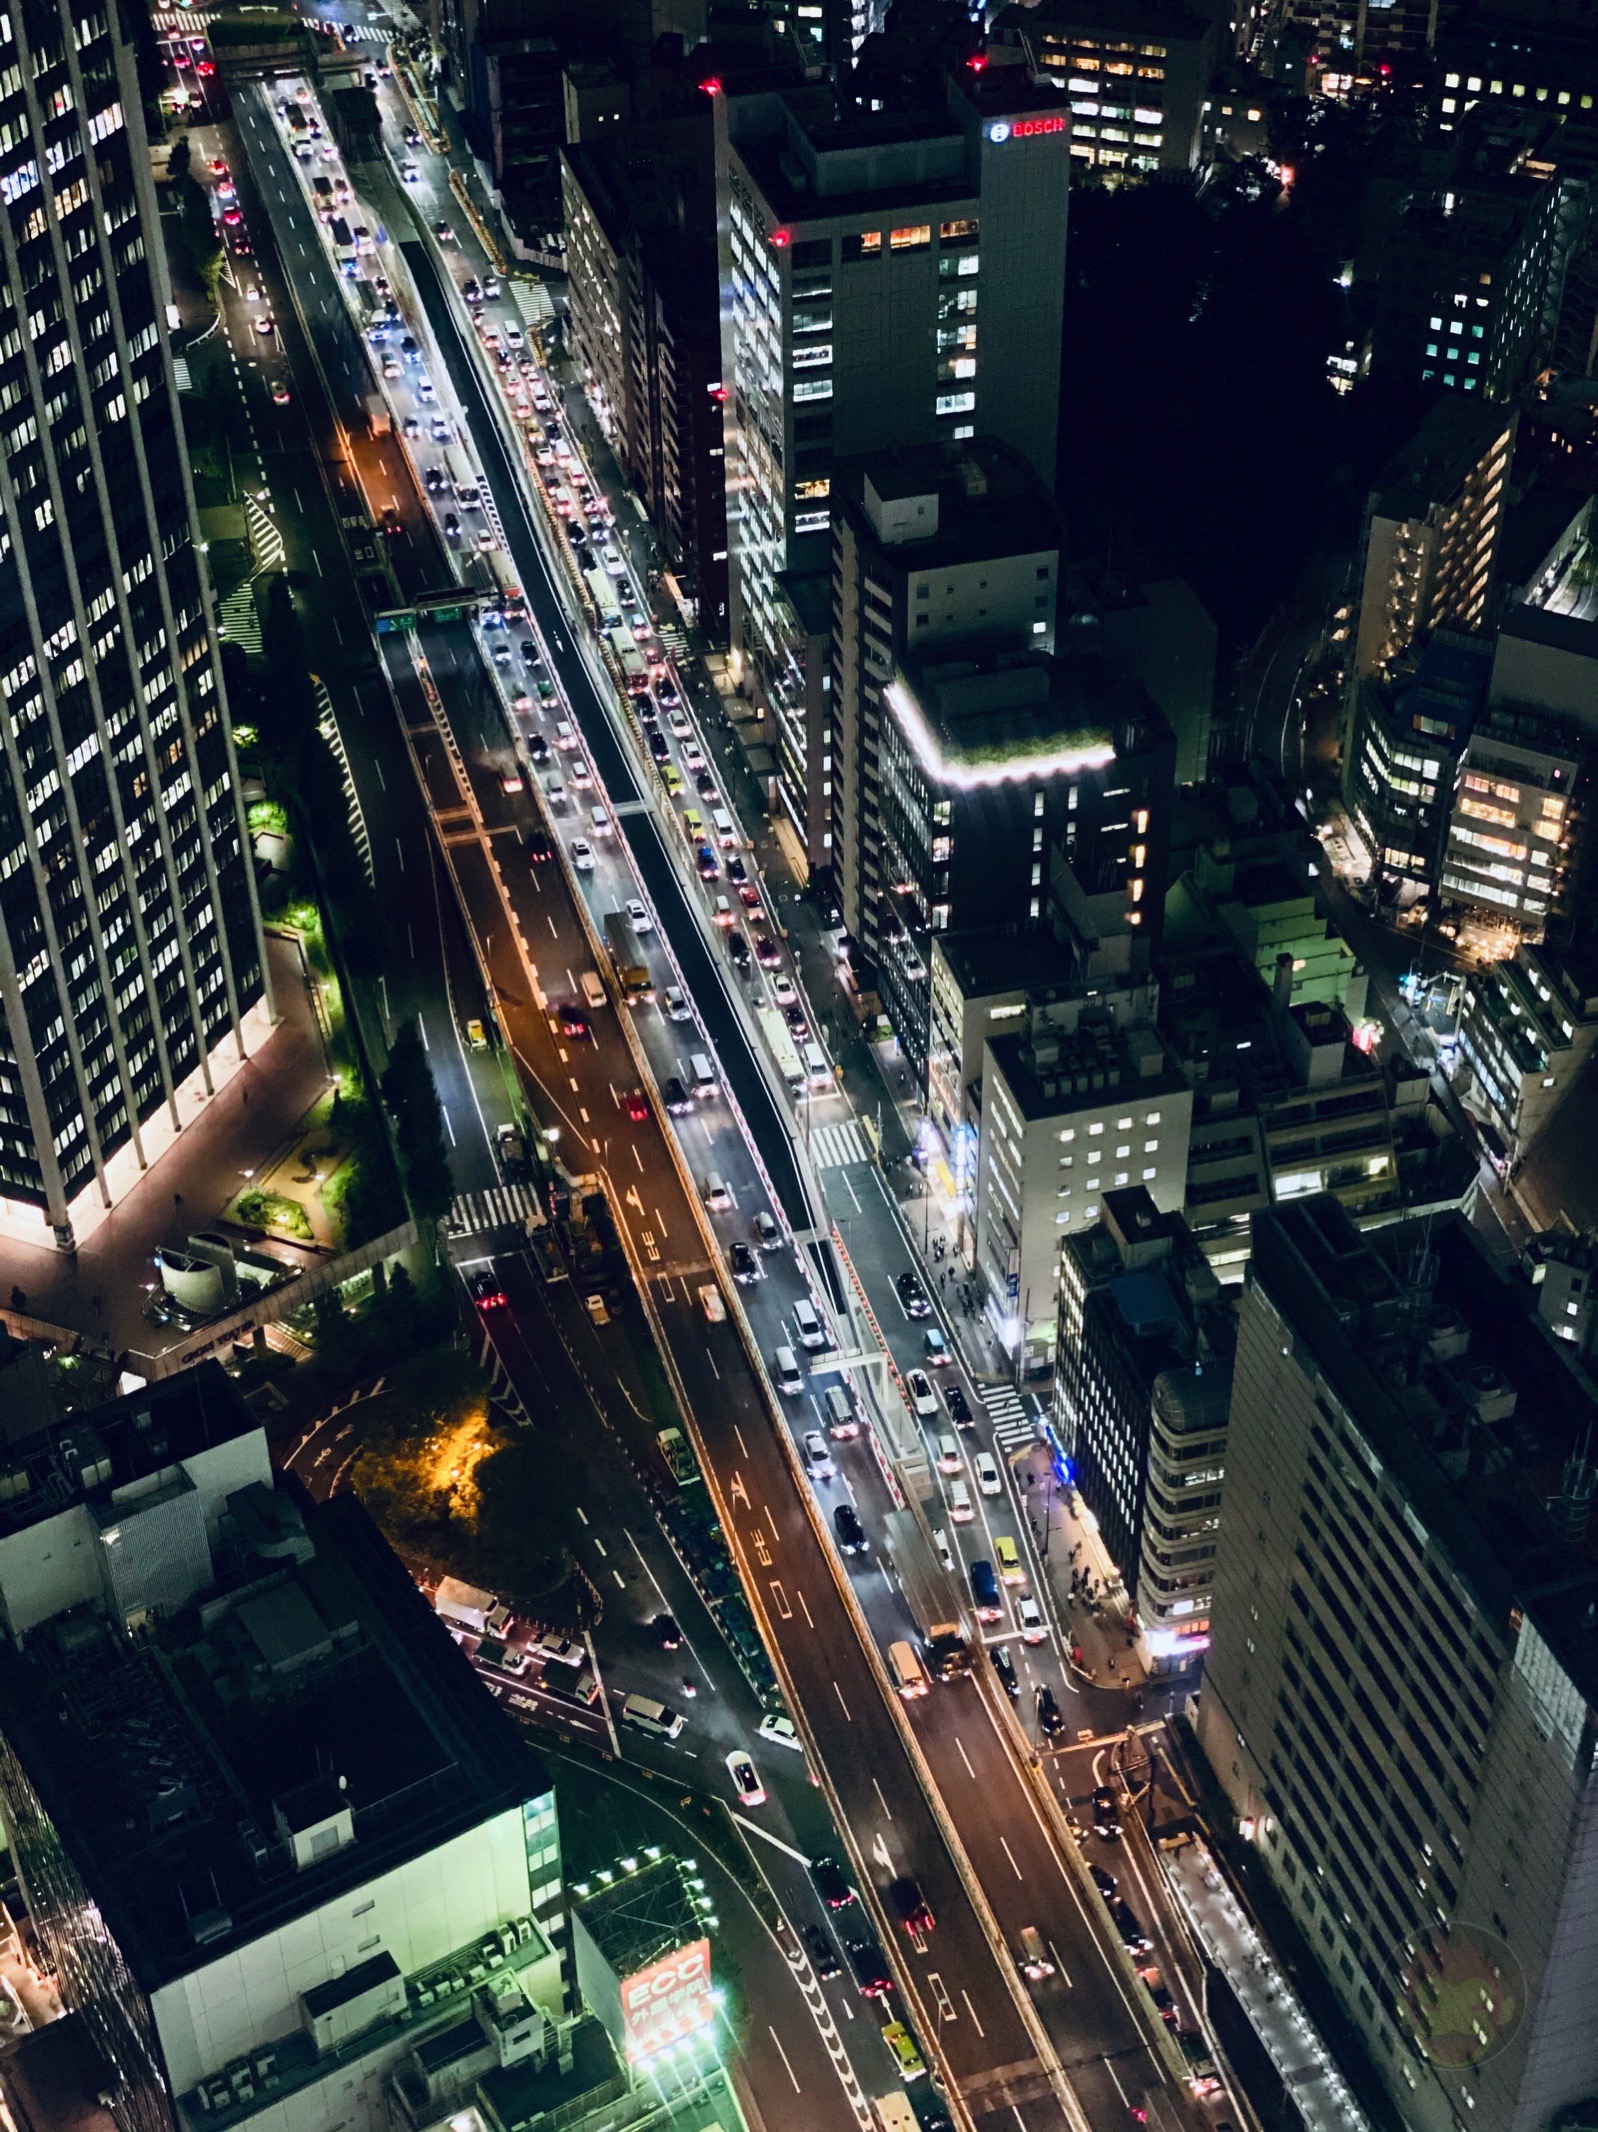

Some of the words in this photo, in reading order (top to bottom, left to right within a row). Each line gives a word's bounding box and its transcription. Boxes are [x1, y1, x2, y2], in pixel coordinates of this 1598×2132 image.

[1012, 117, 1065, 138] BOSCH
[182, 1340, 215, 1364] CROSS
[628, 1953, 705, 2010] ECC
